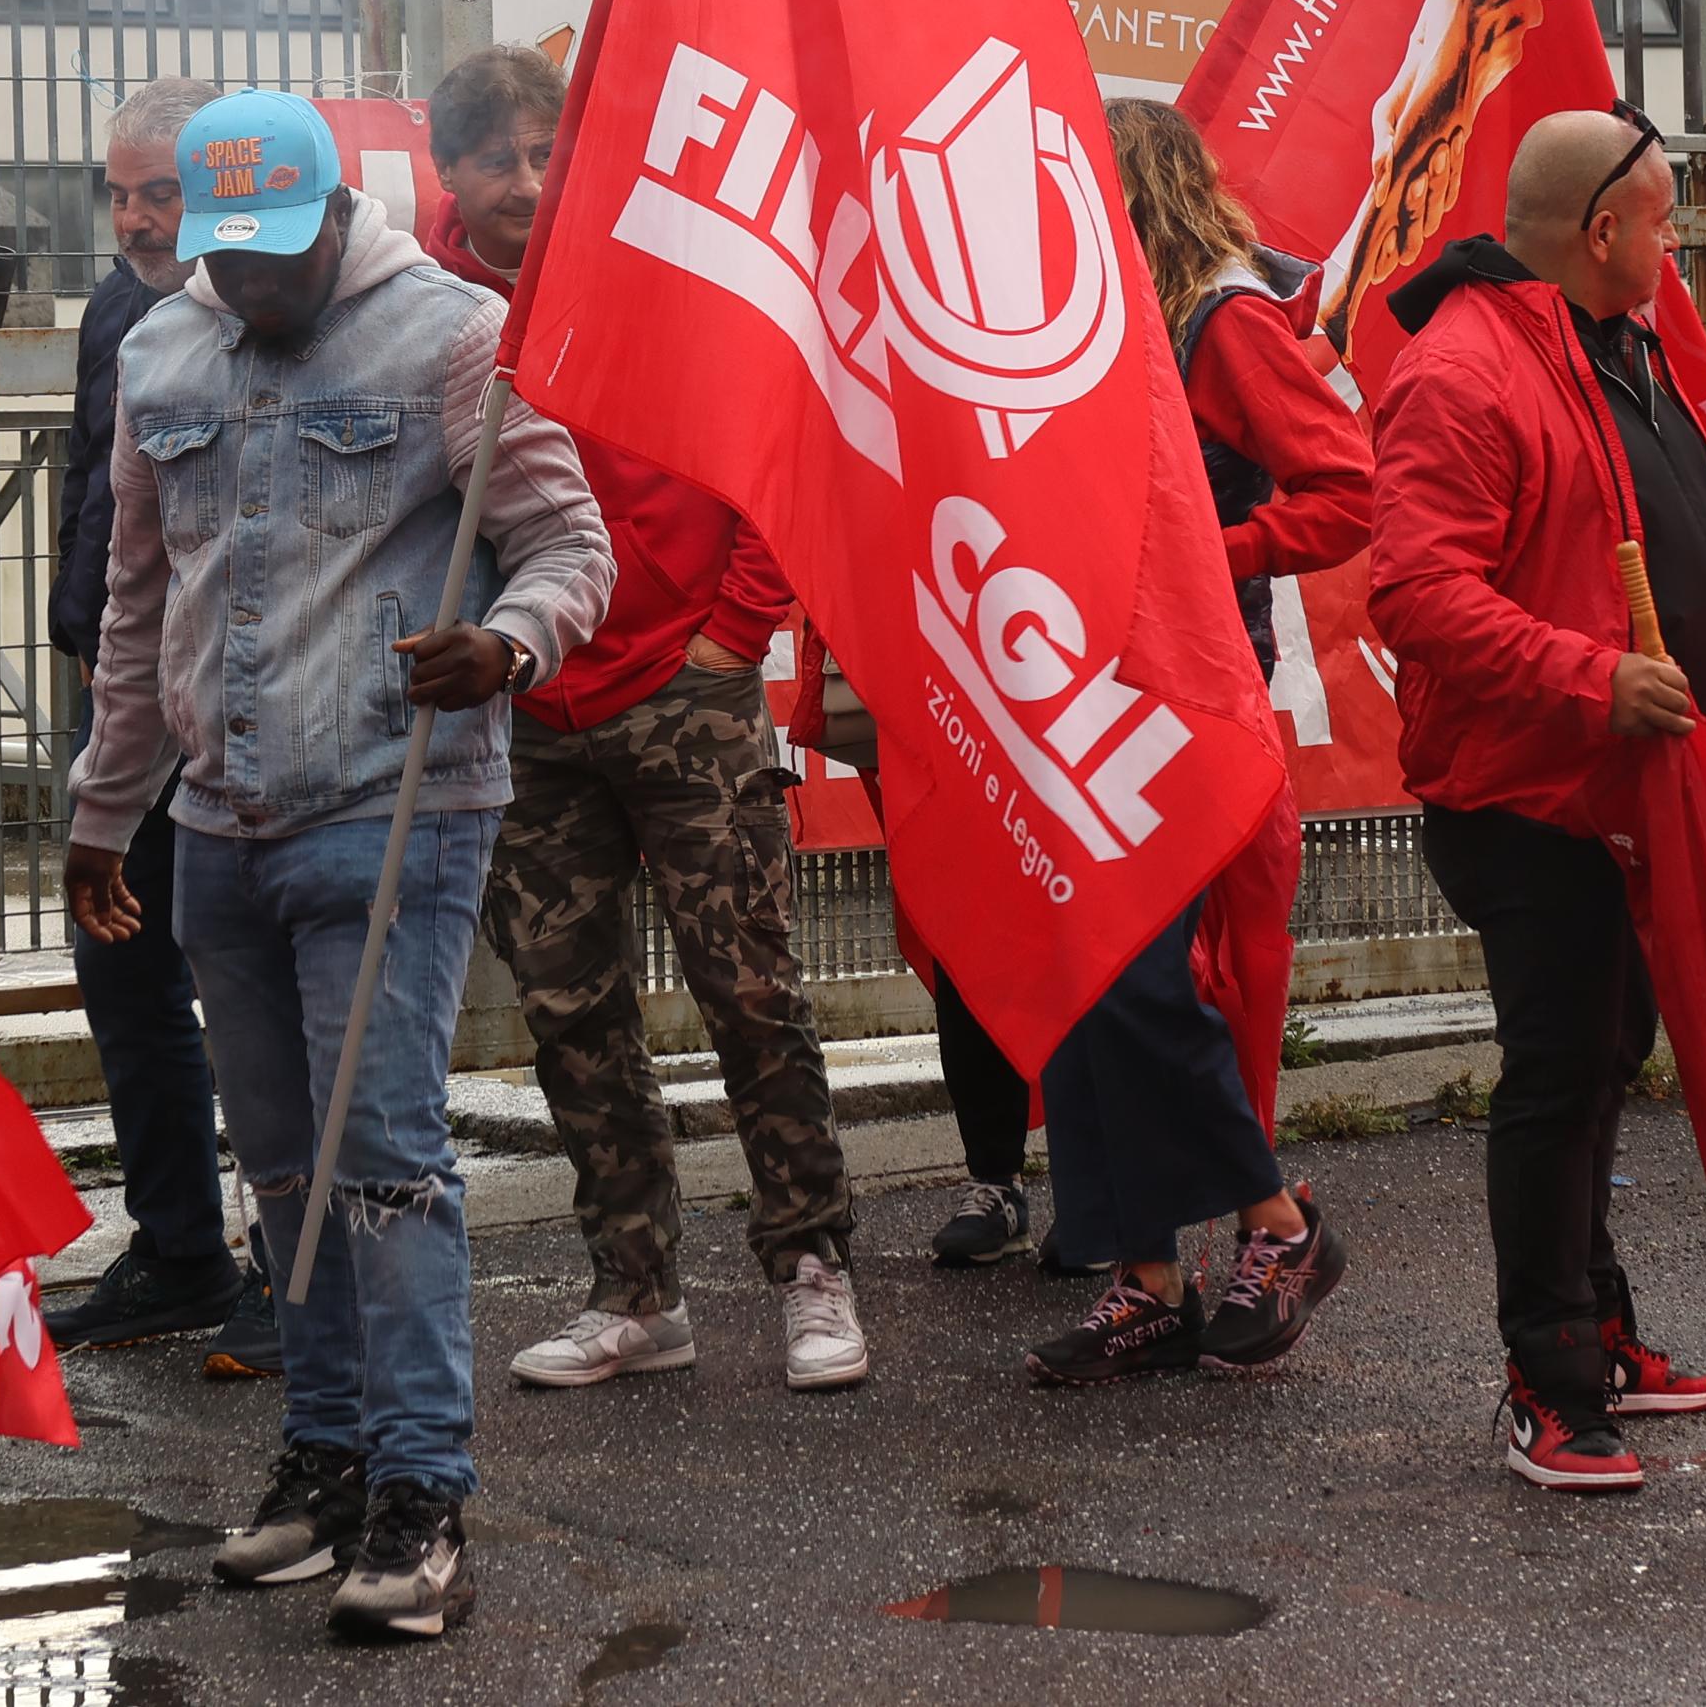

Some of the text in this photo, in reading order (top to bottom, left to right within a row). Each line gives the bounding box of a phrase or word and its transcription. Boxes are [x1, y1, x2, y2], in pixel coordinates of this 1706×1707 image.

[205, 136, 263, 170] SPACE
[212, 167, 255, 199] JAM
[930, 495, 1194, 849] CGIL
[924, 675, 1076, 905] zioni e Legno
